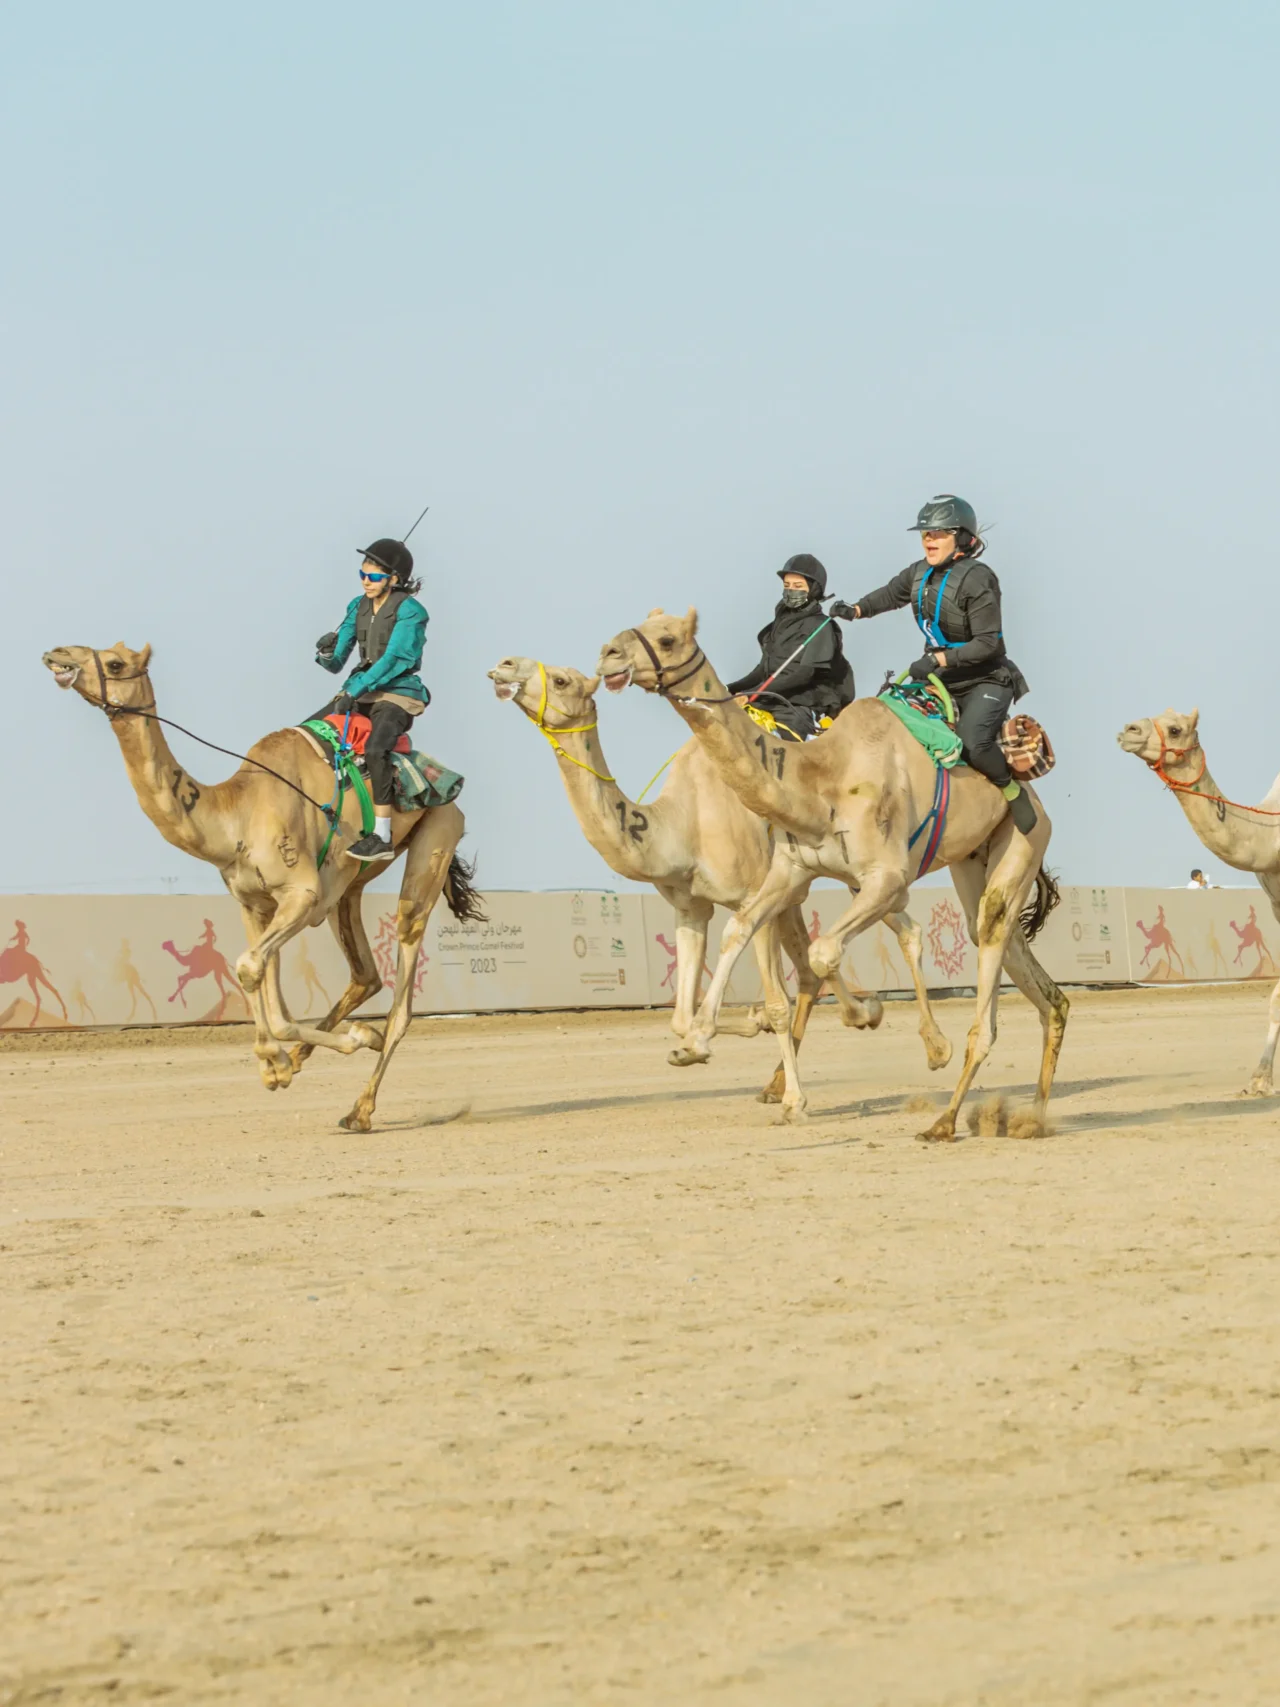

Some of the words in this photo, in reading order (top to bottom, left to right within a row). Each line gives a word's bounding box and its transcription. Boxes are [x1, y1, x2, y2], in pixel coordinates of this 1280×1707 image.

[755, 734, 787, 781] 17
[172, 769, 200, 813] 13
[616, 801, 649, 843] 12
[496, 922, 522, 936] مهرجان
[437, 942, 458, 951] Crown
[459, 941, 480, 951] Prince
[480, 941, 499, 951] Camel
[500, 940, 524, 950] Festival
[470, 957, 497, 974] 2023
